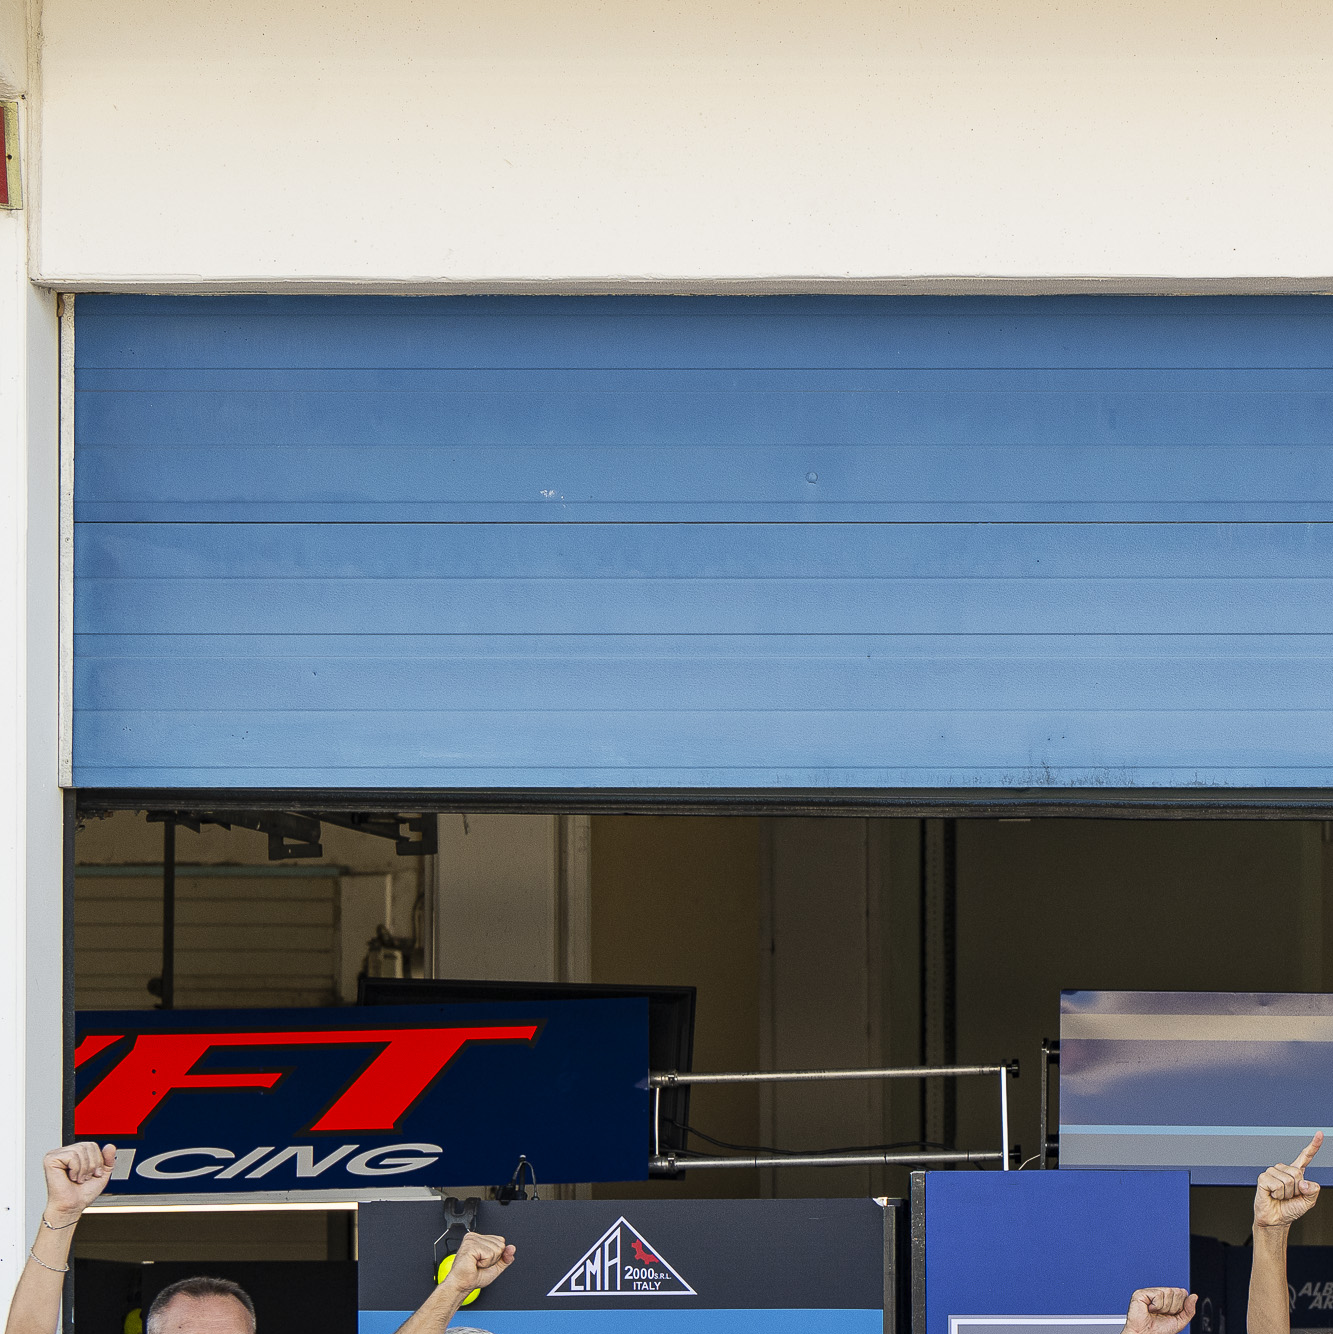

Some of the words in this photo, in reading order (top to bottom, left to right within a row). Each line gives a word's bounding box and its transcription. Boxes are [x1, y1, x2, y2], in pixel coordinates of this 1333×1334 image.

[110, 1143, 444, 1181] CING
[624, 1266, 655, 1279] 2000
[633, 1281, 661, 1290] ITALY
